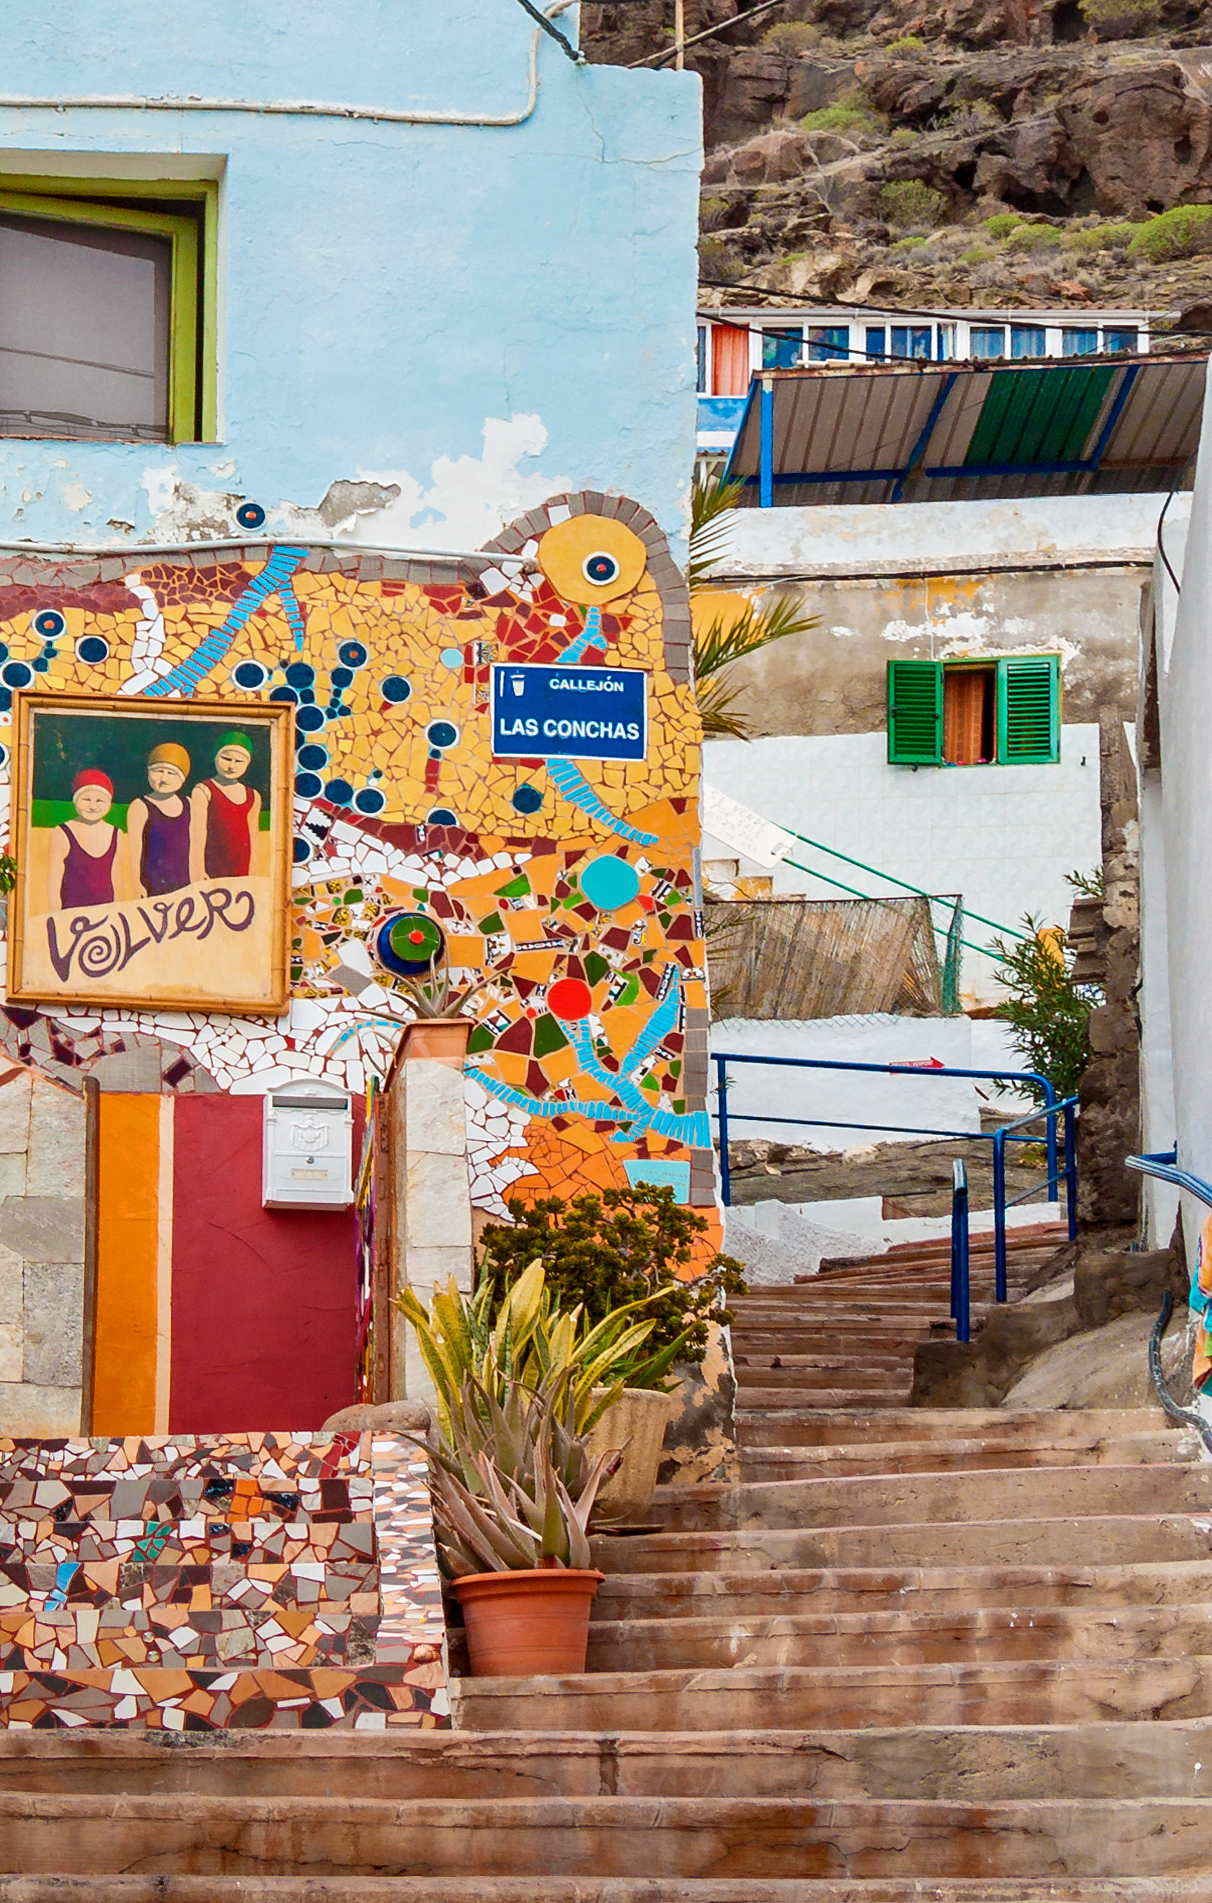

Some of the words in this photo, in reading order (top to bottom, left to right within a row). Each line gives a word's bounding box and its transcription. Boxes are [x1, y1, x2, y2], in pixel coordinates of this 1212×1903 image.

[549, 676, 624, 692] CALLEJÓN
[500, 718, 538, 736] LAS
[543, 719, 640, 740] CONCHAS
[709, 791, 726, 804] SE
[733, 805, 768, 830] VENDE
[737, 819, 764, 837] SALE
